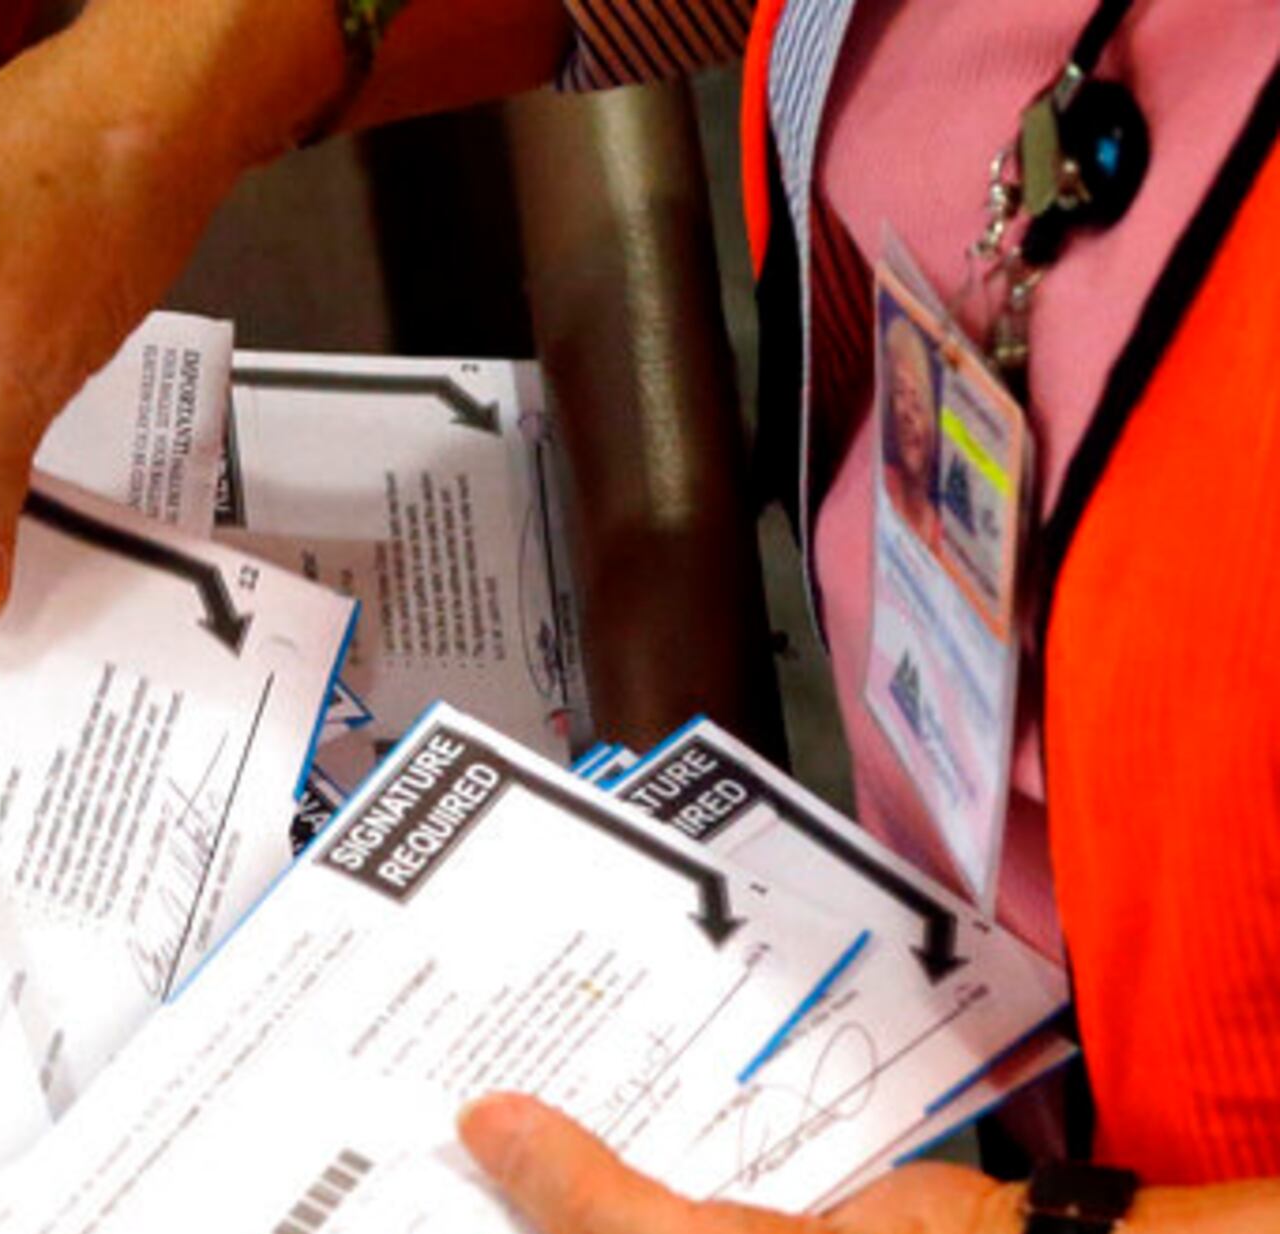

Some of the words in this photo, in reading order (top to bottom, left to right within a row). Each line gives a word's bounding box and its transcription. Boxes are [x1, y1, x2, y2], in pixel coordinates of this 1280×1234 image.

[171, 349, 201, 456] IMPORTANT!
[328, 725, 468, 877] SIGNATURE
[376, 756, 503, 892] REQUIRED
